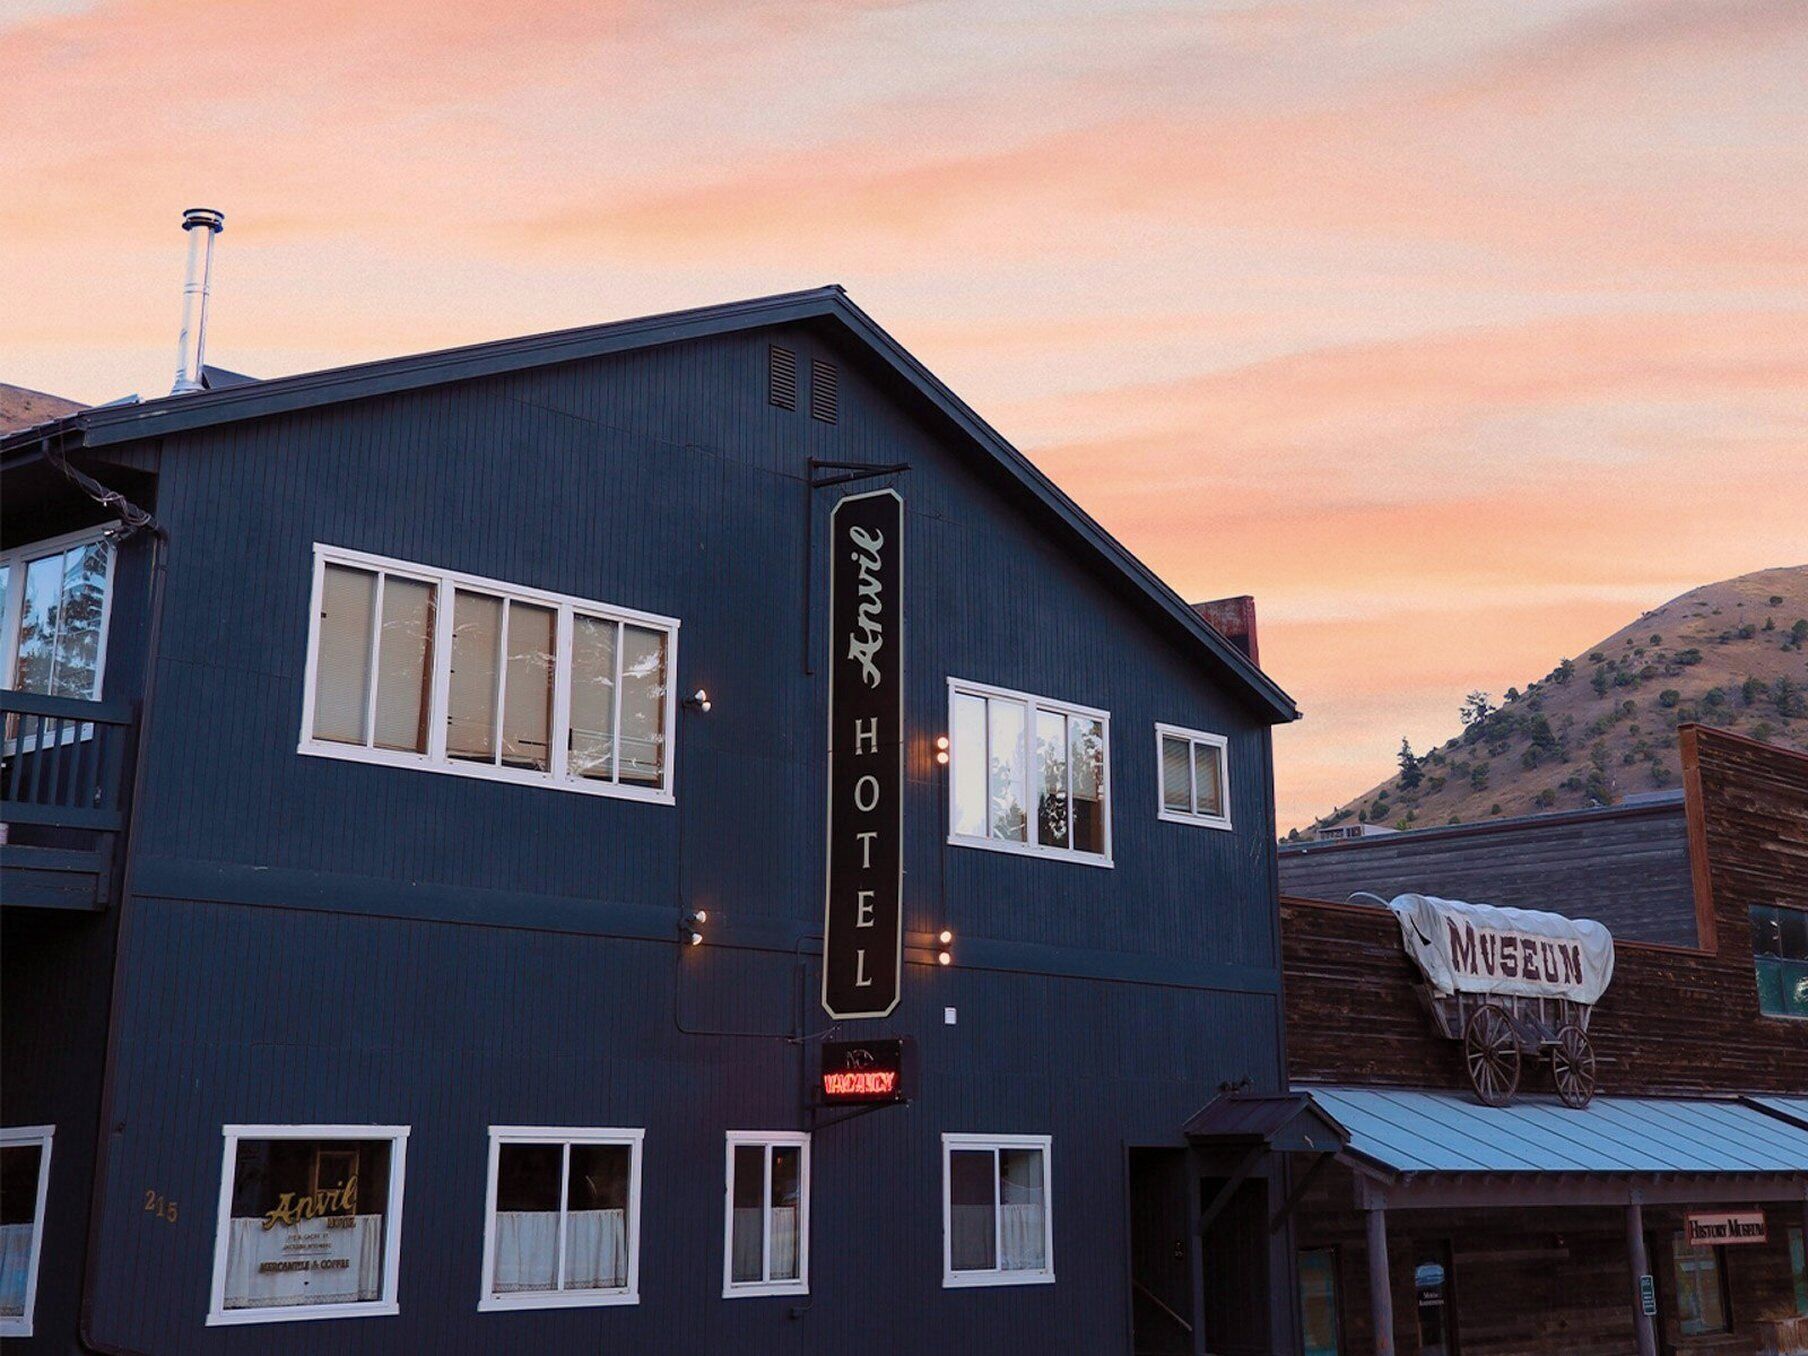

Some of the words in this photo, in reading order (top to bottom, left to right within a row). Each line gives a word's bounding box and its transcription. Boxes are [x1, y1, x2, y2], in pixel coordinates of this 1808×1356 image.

[848, 525, 884, 689] Anvil
[854, 717, 880, 987] HOTEL
[1445, 916, 1583, 985] MUSEUM
[824, 1072, 895, 1094] VACANCY
[144, 1190, 178, 1223] 215
[262, 1175, 358, 1231] Anvil
[1689, 1220, 1727, 1239] HISTORY
[1728, 1218, 1764, 1237] MUSEUM
